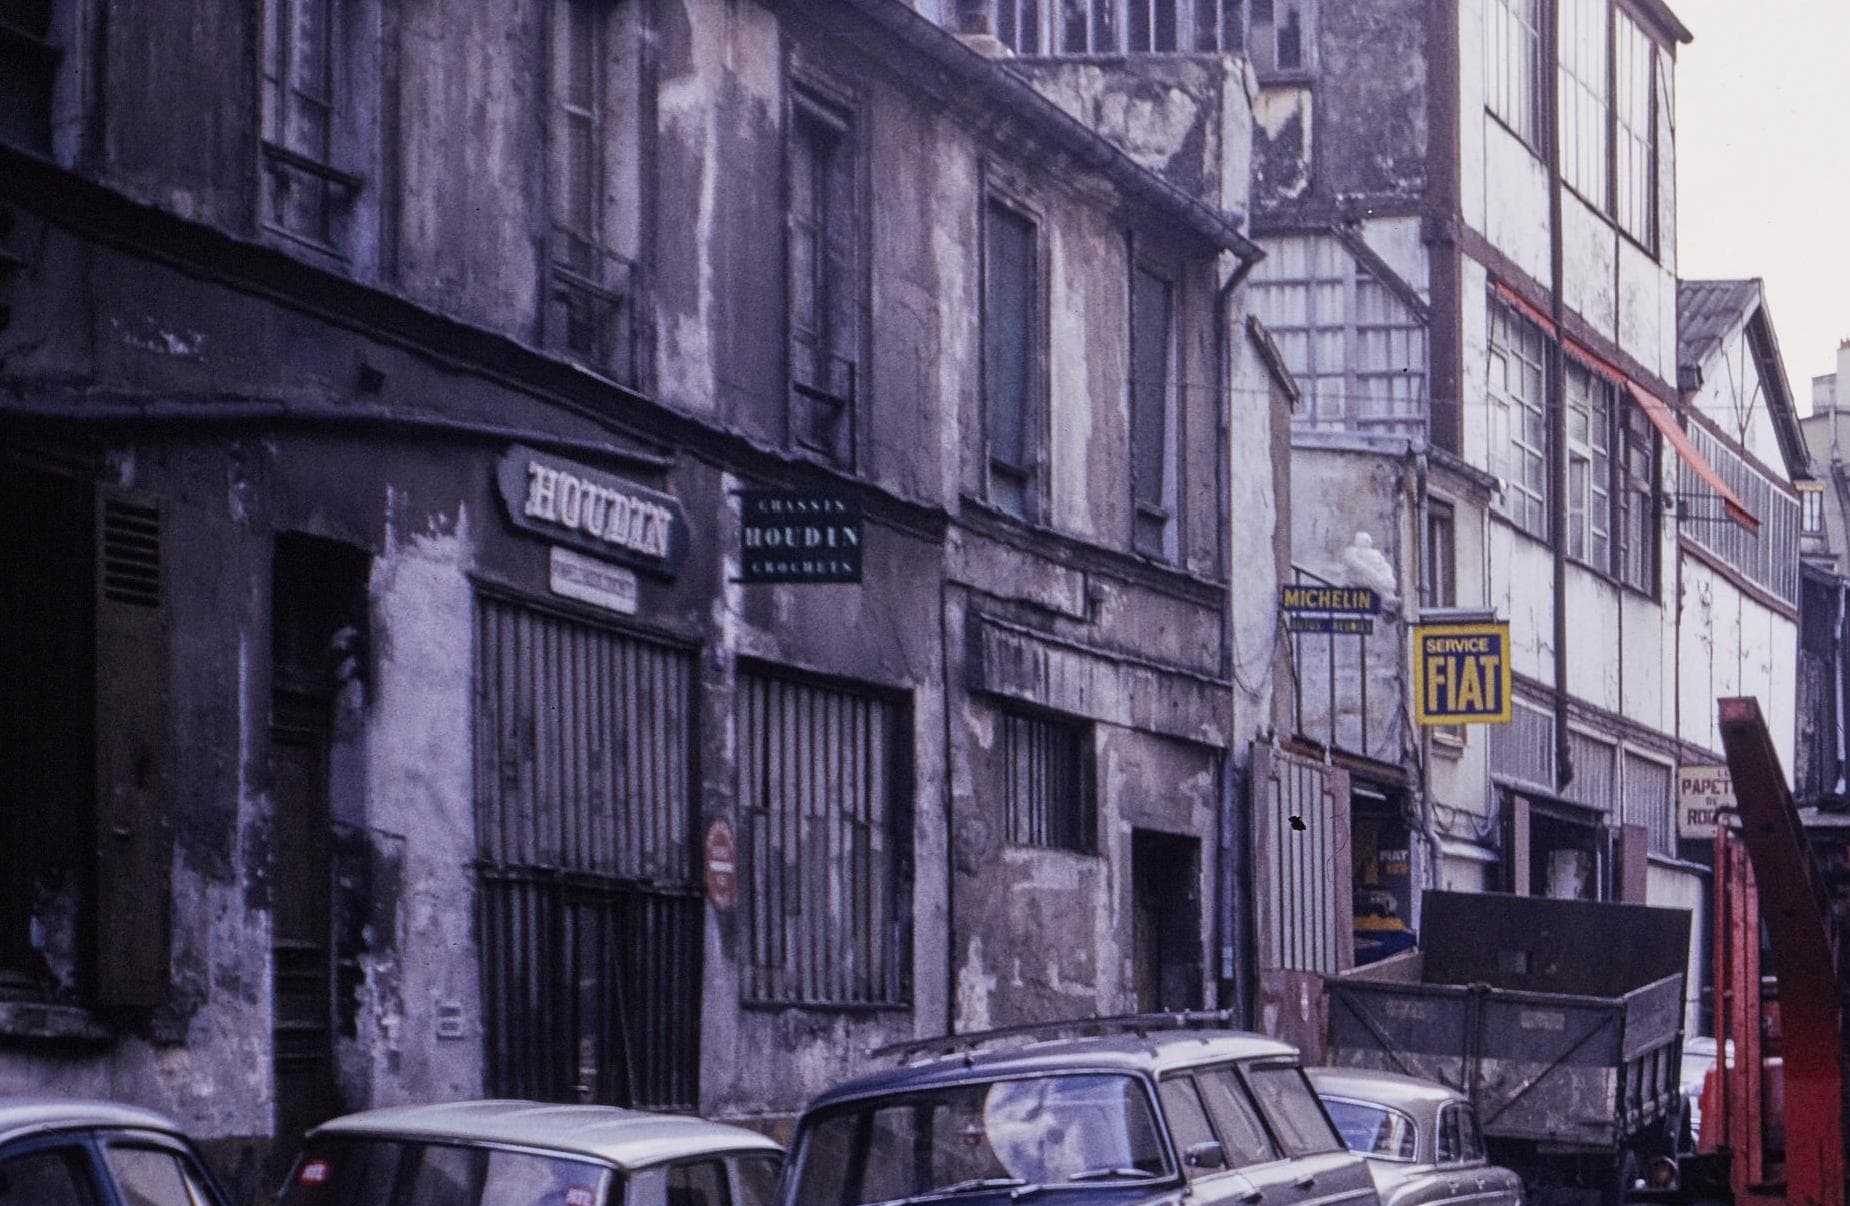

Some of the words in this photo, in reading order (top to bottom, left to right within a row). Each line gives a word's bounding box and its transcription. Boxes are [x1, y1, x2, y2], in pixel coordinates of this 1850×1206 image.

[525, 460, 673, 558] HOUDIN
[745, 526, 858, 547] HOUDIN
[1284, 589, 1371, 609] MICHELIN
[1426, 637, 1489, 654] SERVICE
[1427, 655, 1500, 712] FIAT
[1681, 779, 1734, 795] PAPET
